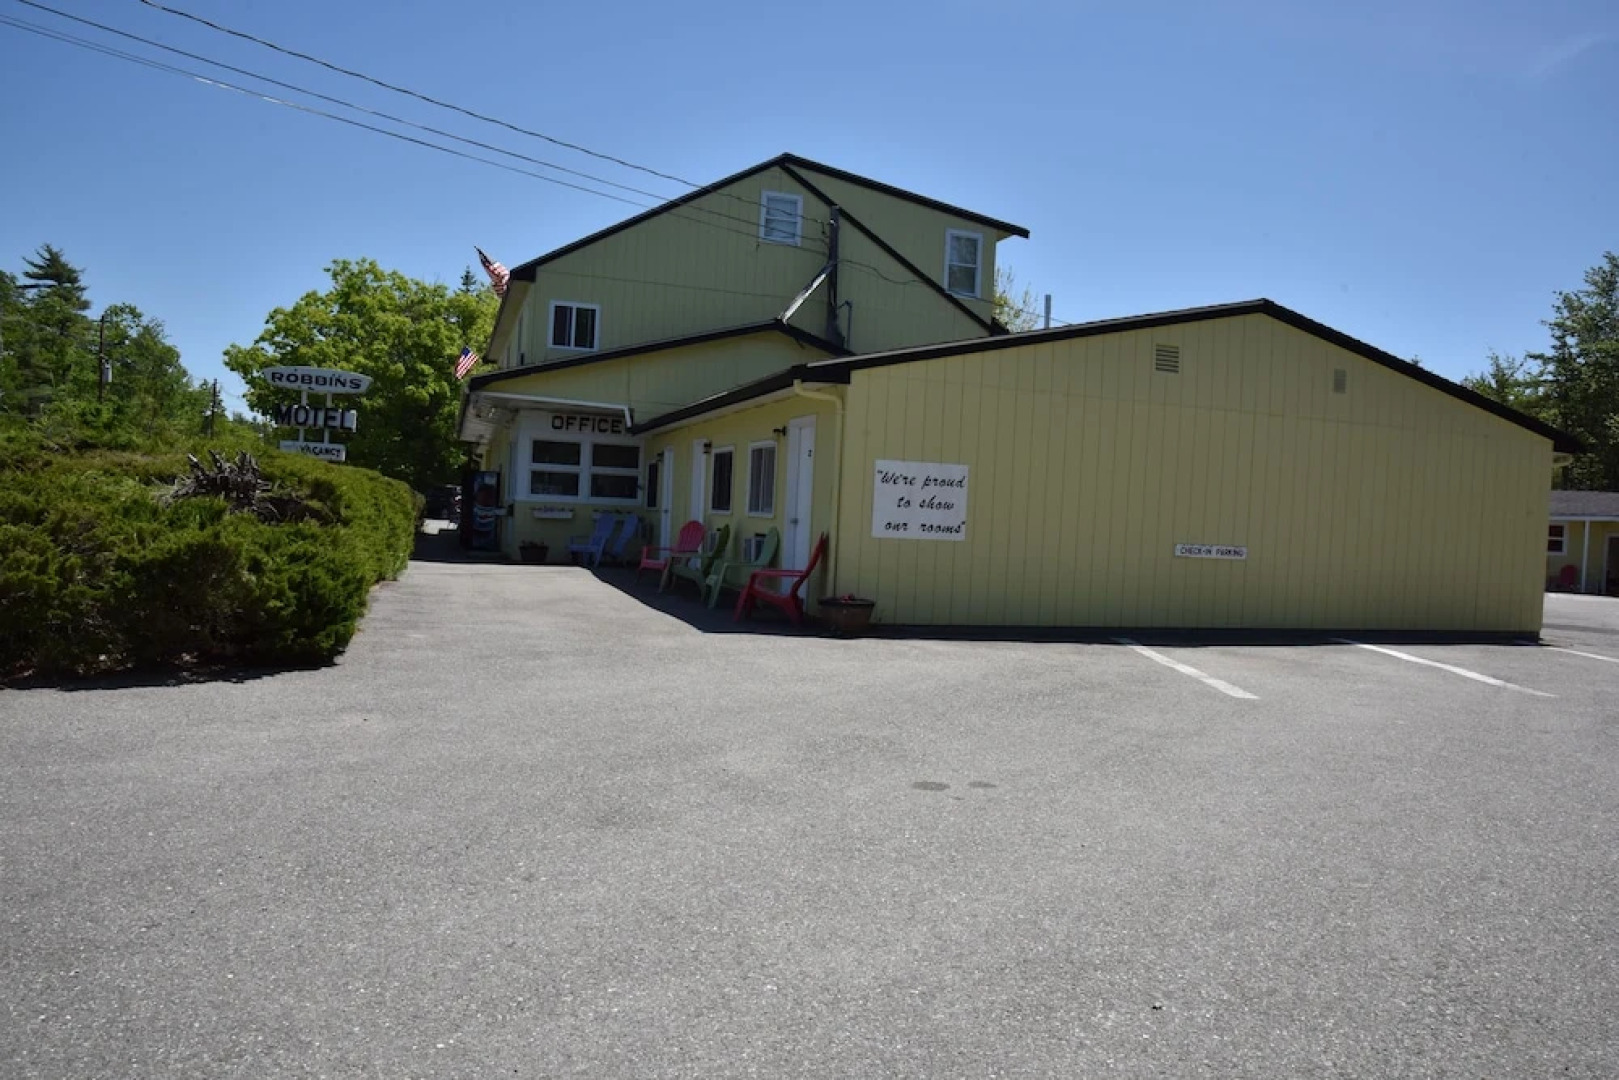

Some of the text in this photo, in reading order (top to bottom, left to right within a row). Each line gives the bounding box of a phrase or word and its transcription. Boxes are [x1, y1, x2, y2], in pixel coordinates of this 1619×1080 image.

[271, 372, 362, 390] ROBBINS
[276, 404, 352, 430] MOTEL
[551, 415, 623, 434] OFFICE
[300, 443, 341, 458] VACANCY
[921, 475, 966, 490] proud
[897, 495, 955, 510] to show
[884, 521, 908, 532] our
[1180, 546, 1245, 558] CHECK-IN PARKING
